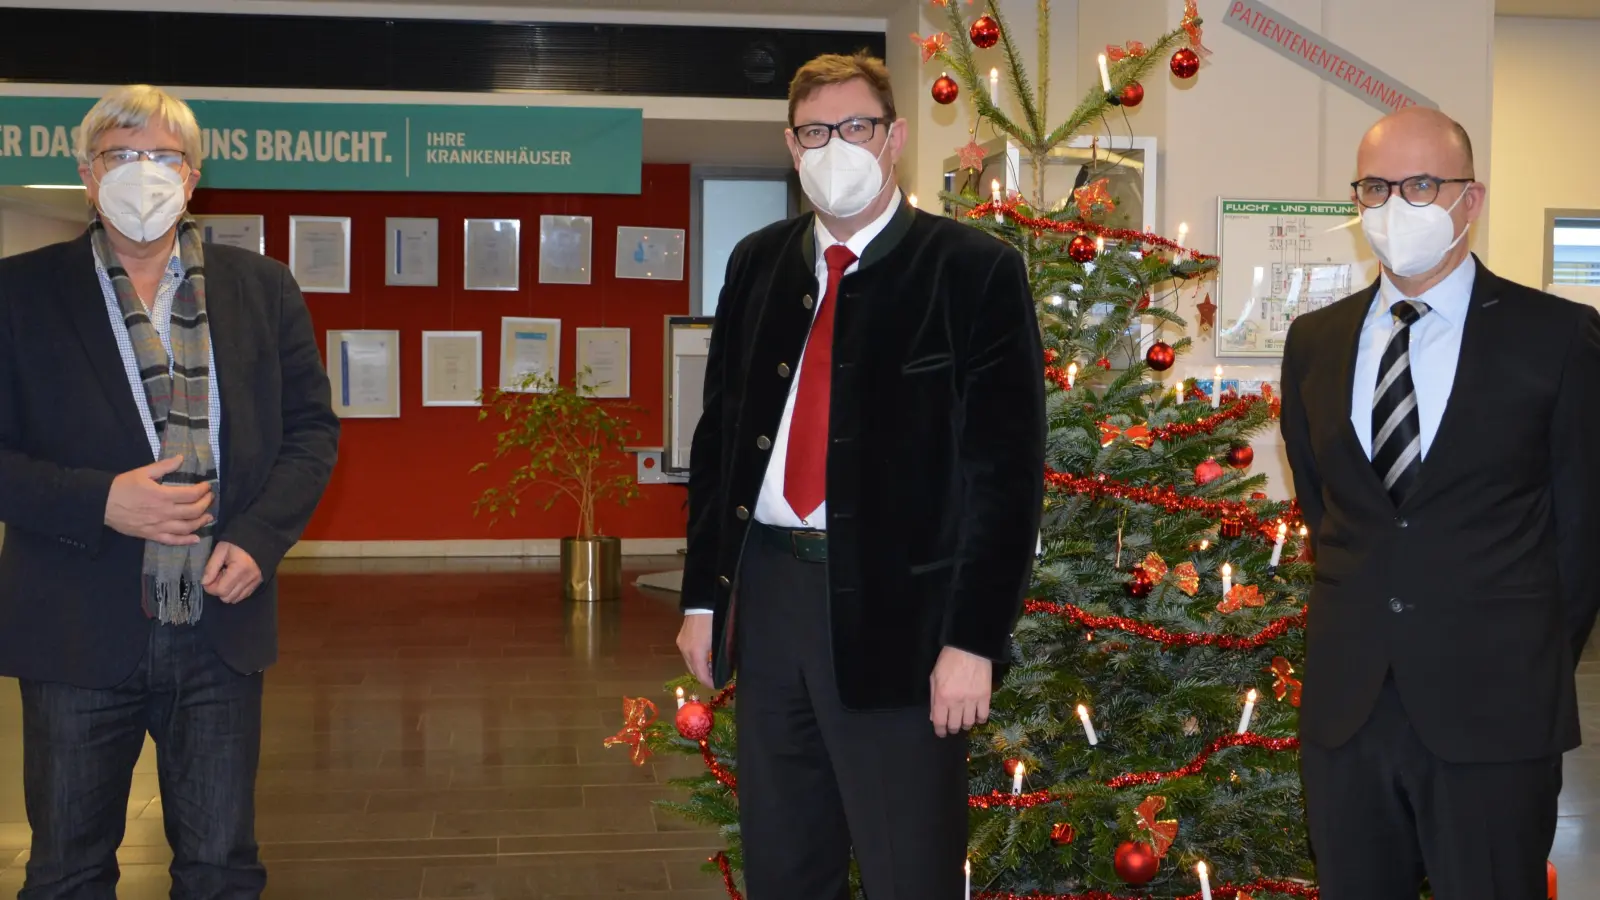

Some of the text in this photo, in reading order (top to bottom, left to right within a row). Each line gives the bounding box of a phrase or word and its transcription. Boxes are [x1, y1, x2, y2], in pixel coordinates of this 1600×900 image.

[1229, 1, 1417, 112] PATIENTENENTERTAINME
[0, 124, 22, 157] R
[256, 129, 392, 162] BRAUCHT.
[427, 132, 465, 147] IHRE
[426, 146, 571, 165] KRANKENHÄUSER
[1226, 203, 1270, 212] FLUCHT
[1281, 205, 1307, 213] UND
